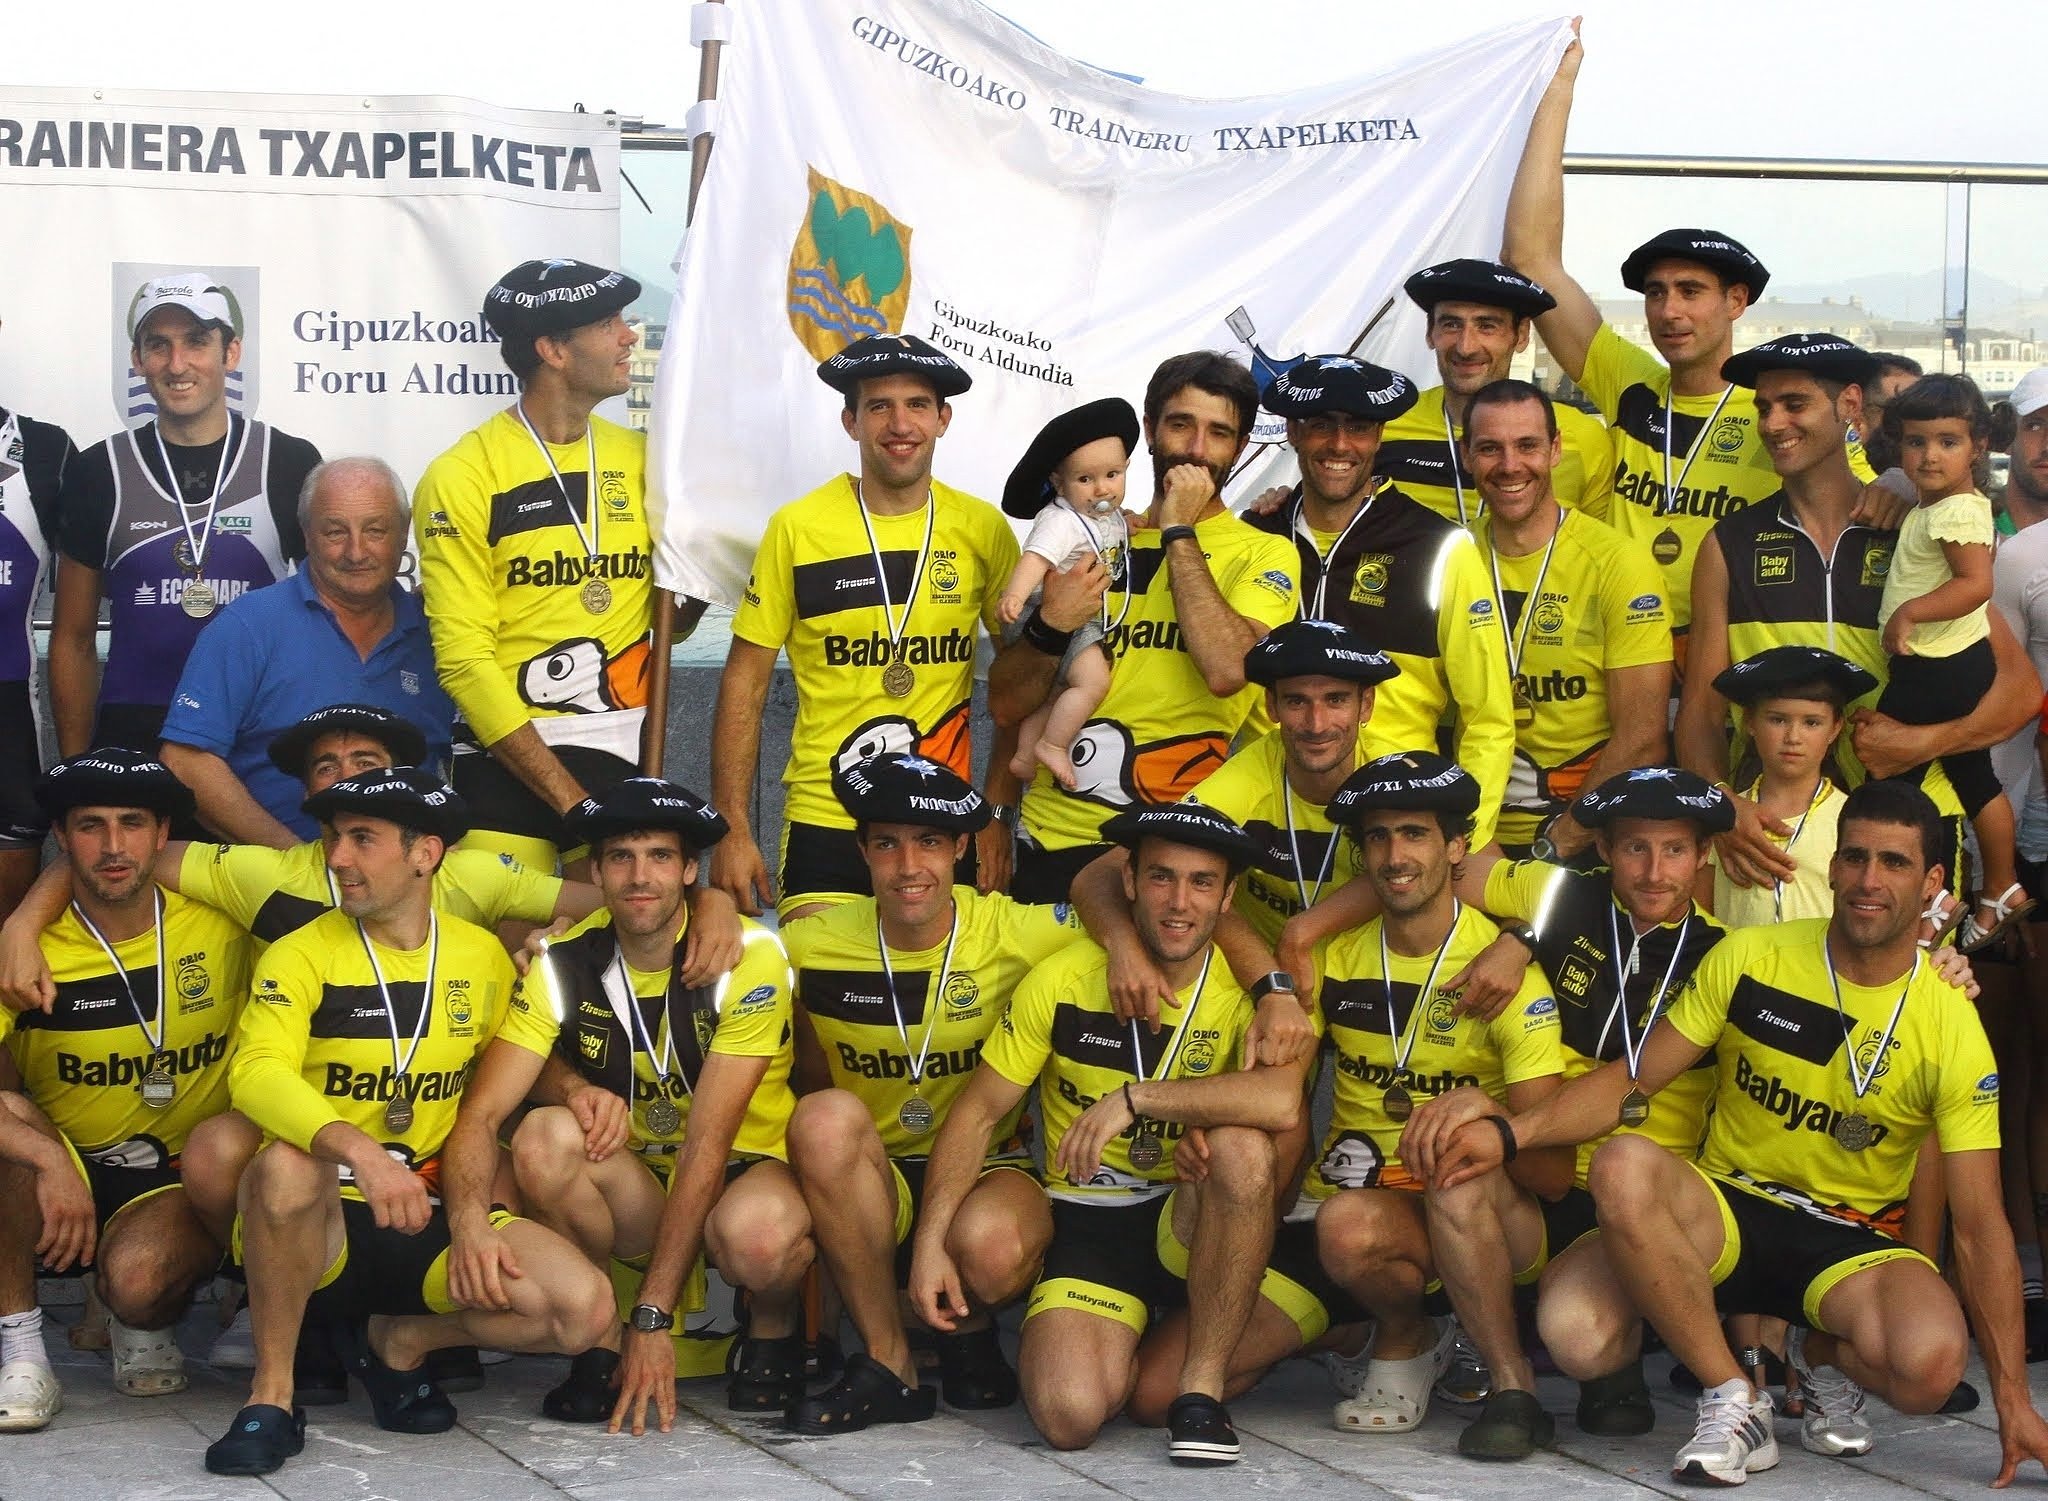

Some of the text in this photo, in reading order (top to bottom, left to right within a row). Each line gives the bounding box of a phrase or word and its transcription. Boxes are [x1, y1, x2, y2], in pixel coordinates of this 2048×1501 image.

[852, 16, 1421, 153] GIPUZKOAKO TRAINERU TXAPELKETA
[0, 118, 602, 193] RAINERA TXAPELKETA
[293, 310, 501, 351] Gipuzkoak
[934, 299, 1053, 352] Gipuzkoako
[928, 322, 1075, 387] Foru Aldundia
[293, 361, 523, 396] Foru Aldun
[1723, 416, 1751, 426] ORIO
[601, 471, 626, 480] ORIO
[226, 516, 252, 527] ACT
[933, 550, 957, 560] ORIO
[1761, 555, 1789, 569] Baby
[1761, 566, 1786, 577] auto
[834, 576, 876, 590] Zirauna
[1541, 592, 1569, 603] ORIO
[823, 627, 973, 667] Babyauto
[178, 951, 206, 967] ORIO
[447, 980, 471, 989] ORIO
[1562, 977, 1586, 997] auto
[71, 997, 117, 1011] Zirauna
[842, 991, 884, 1005] Zirauna
[1756, 1008, 1802, 1034] Zirauna
[1078, 1032, 1123, 1049] Zirauna
[1192, 1028, 1220, 1040] ORIO
[57, 1031, 229, 1093] Babyauto
[1067, 1290, 1125, 1313] Babyauto
